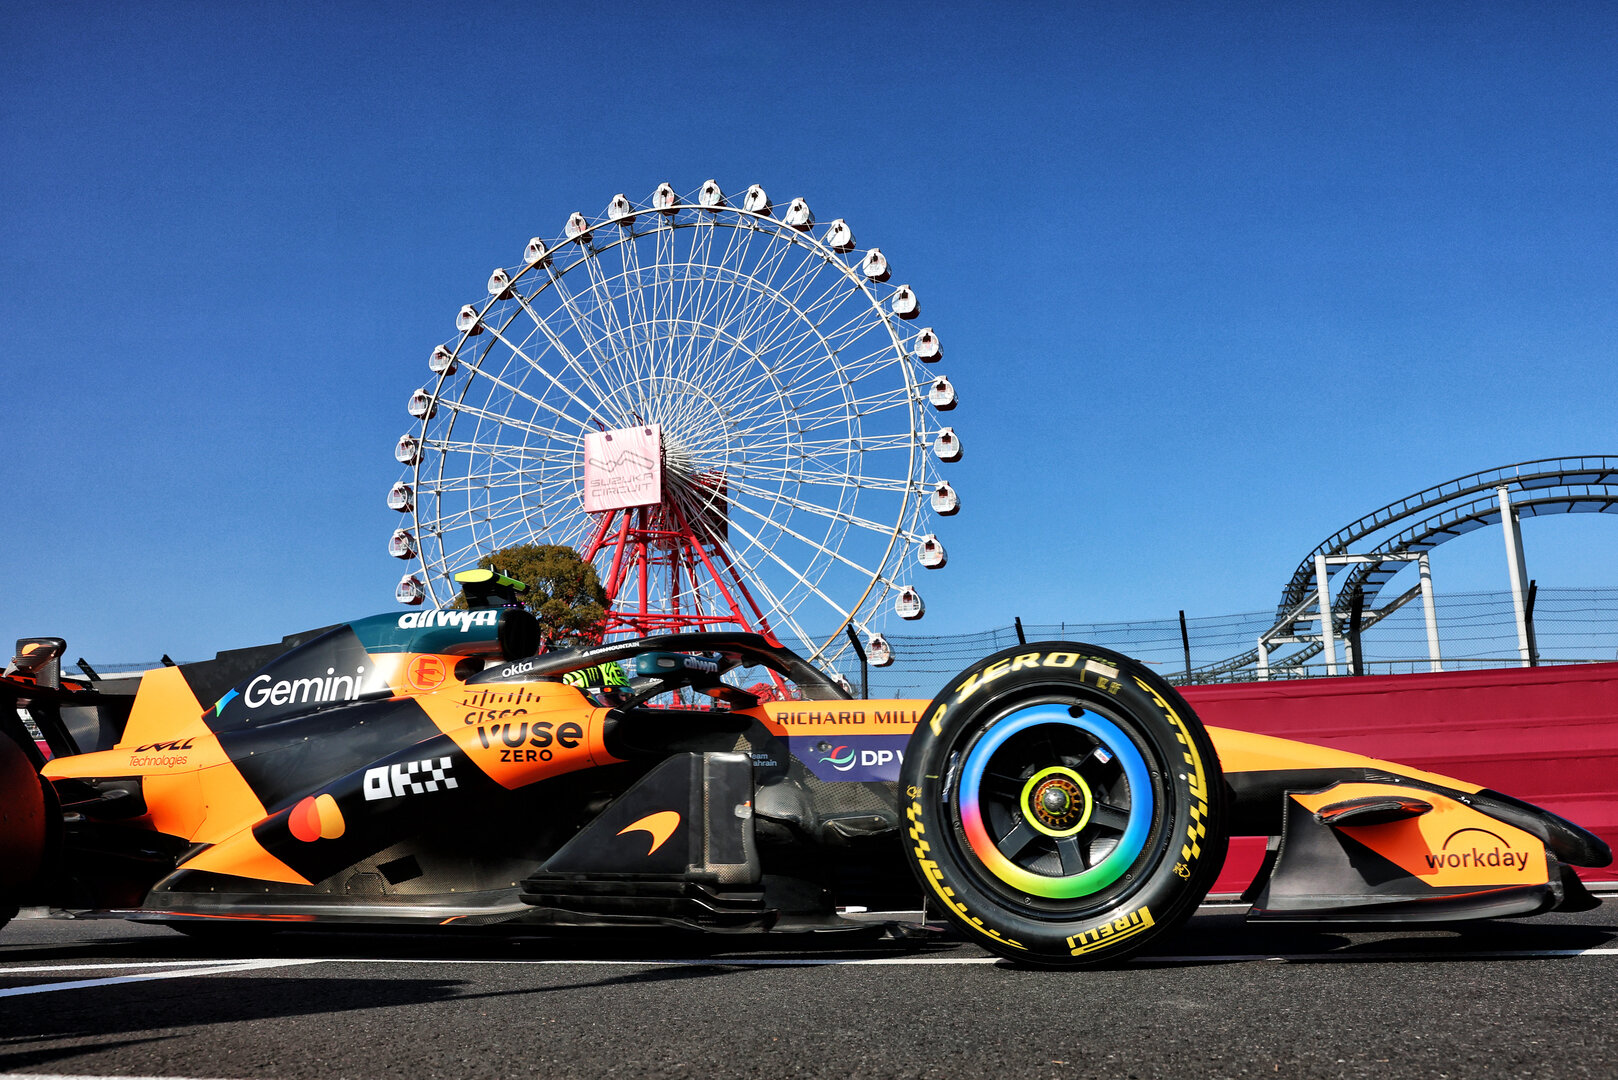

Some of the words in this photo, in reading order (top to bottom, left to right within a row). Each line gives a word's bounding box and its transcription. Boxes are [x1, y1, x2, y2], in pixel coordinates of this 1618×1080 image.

[590, 472, 654, 488] SUZUKA
[591, 482, 653, 497] CIRCUIT
[397, 609, 498, 633] allwyn
[501, 661, 534, 678] okta
[244, 665, 365, 709] Gemini
[929, 703, 948, 737] P
[954, 651, 1081, 704] ZERO
[776, 711, 866, 725] RICHARD
[873, 710, 919, 724] MILL
[129, 755, 188, 768] Technologies
[500, 749, 553, 762] ZERO
[861, 750, 894, 766] DP
[363, 756, 459, 801] OKX
[1425, 847, 1529, 872] workday
[1065, 905, 1155, 956] PIRELLI
